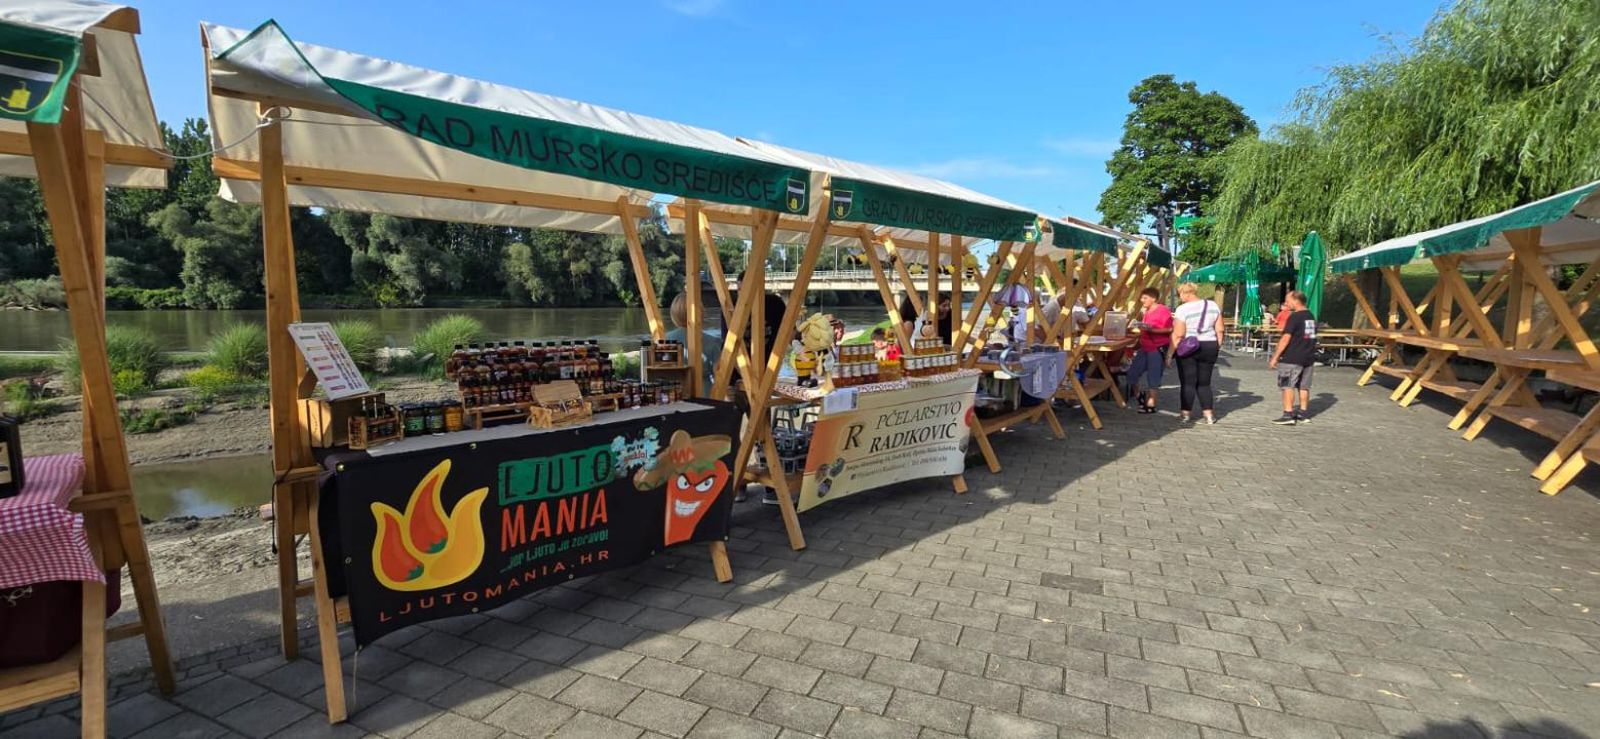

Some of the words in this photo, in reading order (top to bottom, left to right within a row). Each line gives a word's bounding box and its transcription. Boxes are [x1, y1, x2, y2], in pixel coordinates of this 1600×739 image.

[374, 103, 474, 149] RAD
[490, 124, 643, 180] MURSKO
[862, 198, 899, 222] GRAD
[902, 204, 963, 230] MURSKO
[869, 417, 958, 453] RADIKOVIĆ
[874, 400, 962, 430] PČELARSTVO
[843, 424, 863, 450] R
[504, 451, 611, 499] LJUTO
[501, 488, 608, 552] MANIA
[379, 550, 609, 623] LJUTOMANIA.HR
